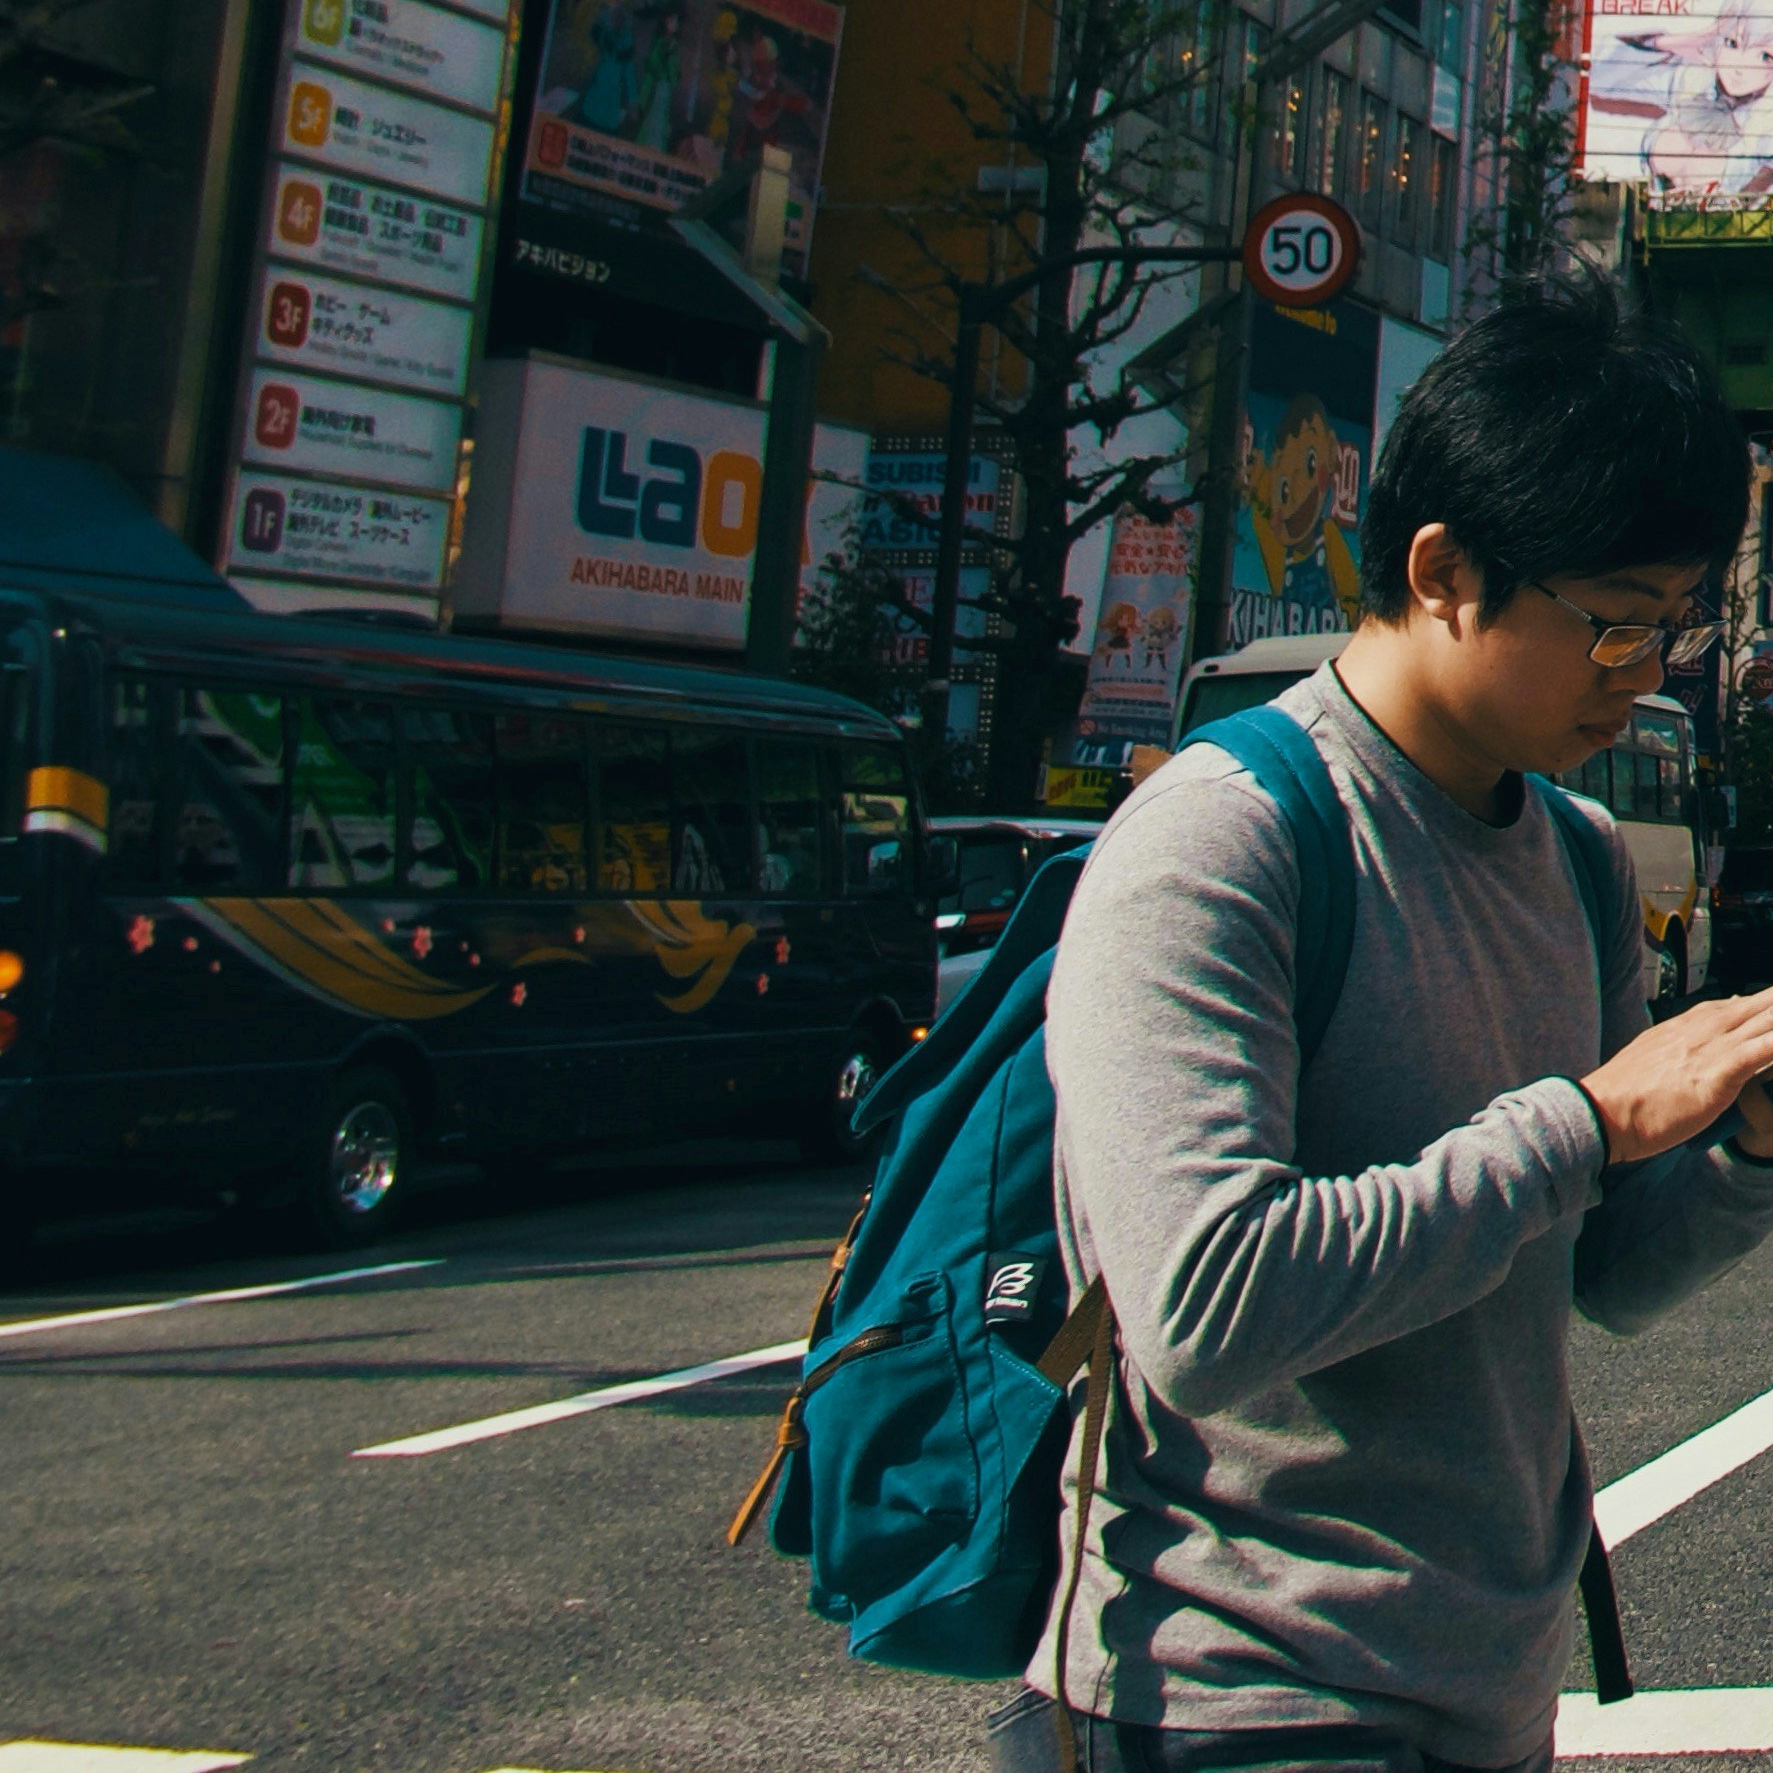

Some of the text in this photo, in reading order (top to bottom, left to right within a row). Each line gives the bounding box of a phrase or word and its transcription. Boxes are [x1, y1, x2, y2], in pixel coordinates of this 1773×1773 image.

[1270, 229, 1333, 276] 50
[571, 557, 743, 604] AKIHABARA MAIN
